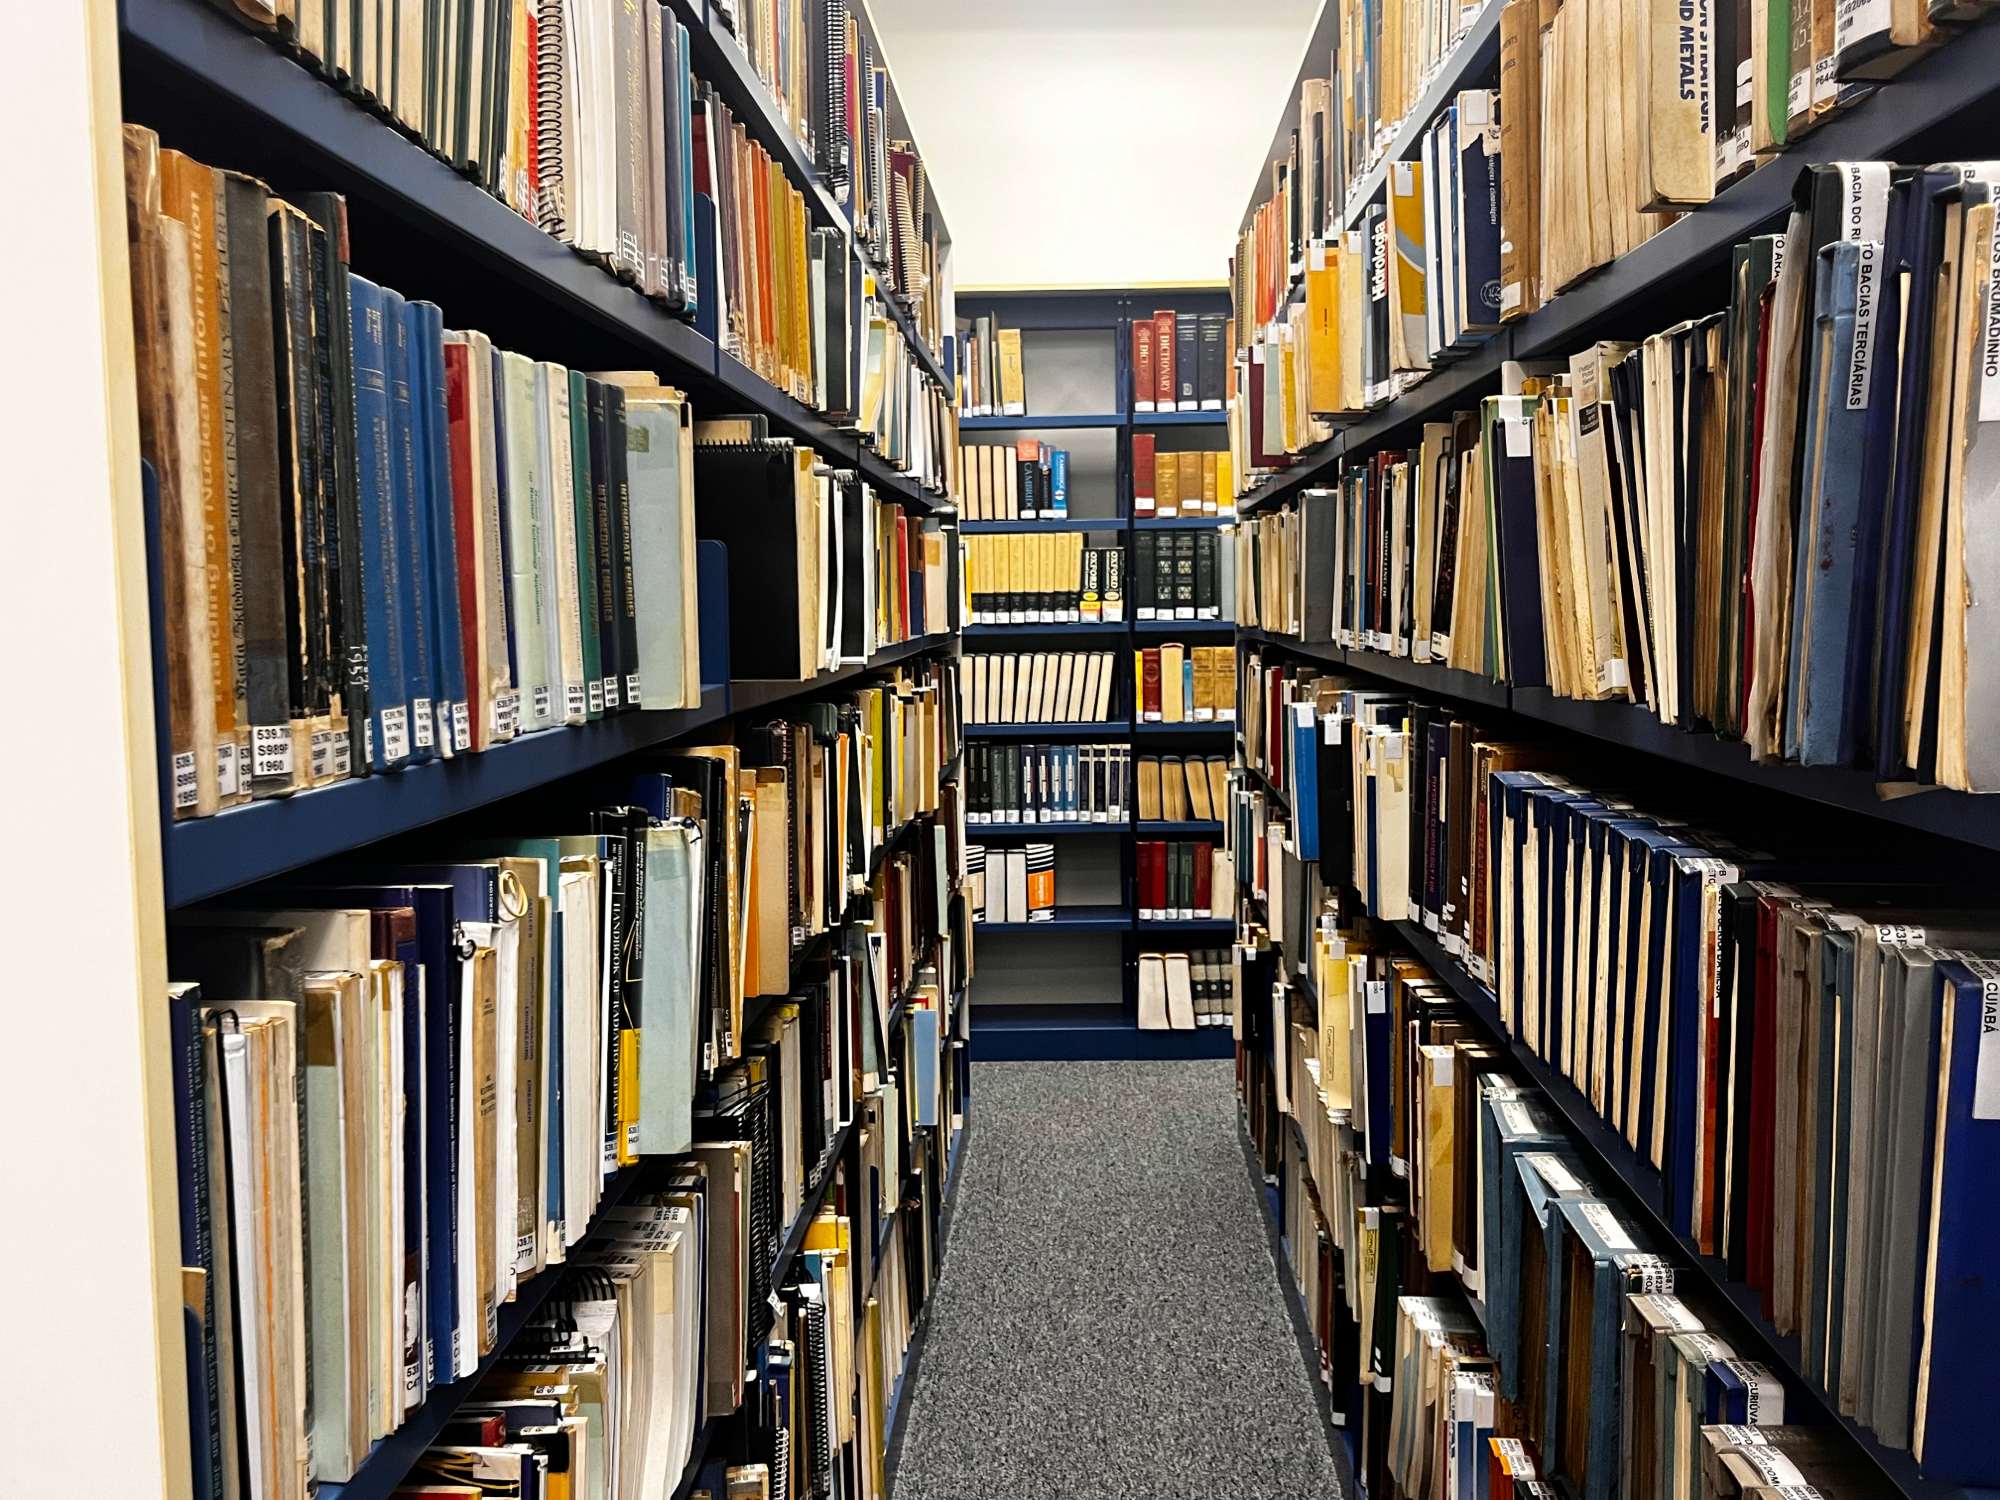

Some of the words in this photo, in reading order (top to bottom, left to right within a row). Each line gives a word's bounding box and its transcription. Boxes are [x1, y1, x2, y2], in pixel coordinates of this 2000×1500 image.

[1679, 26, 1696, 100] METALS
[1850, 167, 1862, 203] BACIA
[1851, 207, 1862, 225] DO
[191, 191, 209, 381] Information
[1372, 221, 1387, 302] Hidrologia
[1859, 263, 1874, 317] BACIAS
[1161, 334, 1171, 393] DICTIONARY
[1849, 320, 1872, 406] TERCIÁRIAS
[199, 394, 214, 512] Nuclear
[205, 523, 217, 554] of
[598, 483, 611, 567] INTERMEDIATE
[620, 483, 633, 564] INTERMEDIATE
[602, 568, 615, 623] ENERGIES
[624, 564, 636, 618] ENERGIES
[1089, 550, 1098, 590] OXFORD
[1110, 550, 1119, 589] OXFORD
[258, 760, 285, 772] 1960
[613, 902, 622, 974] HANDBOOK
[612, 979, 621, 996] OF
[1984, 982, 1999, 1034] CUIABÁ
[191, 1009, 201, 1090] Accidental
[612, 1000, 621, 1072] RADIATION
[195, 1099, 208, 1199] Overexposure
[1748, 1380, 1760, 1426] CURIÚVA
